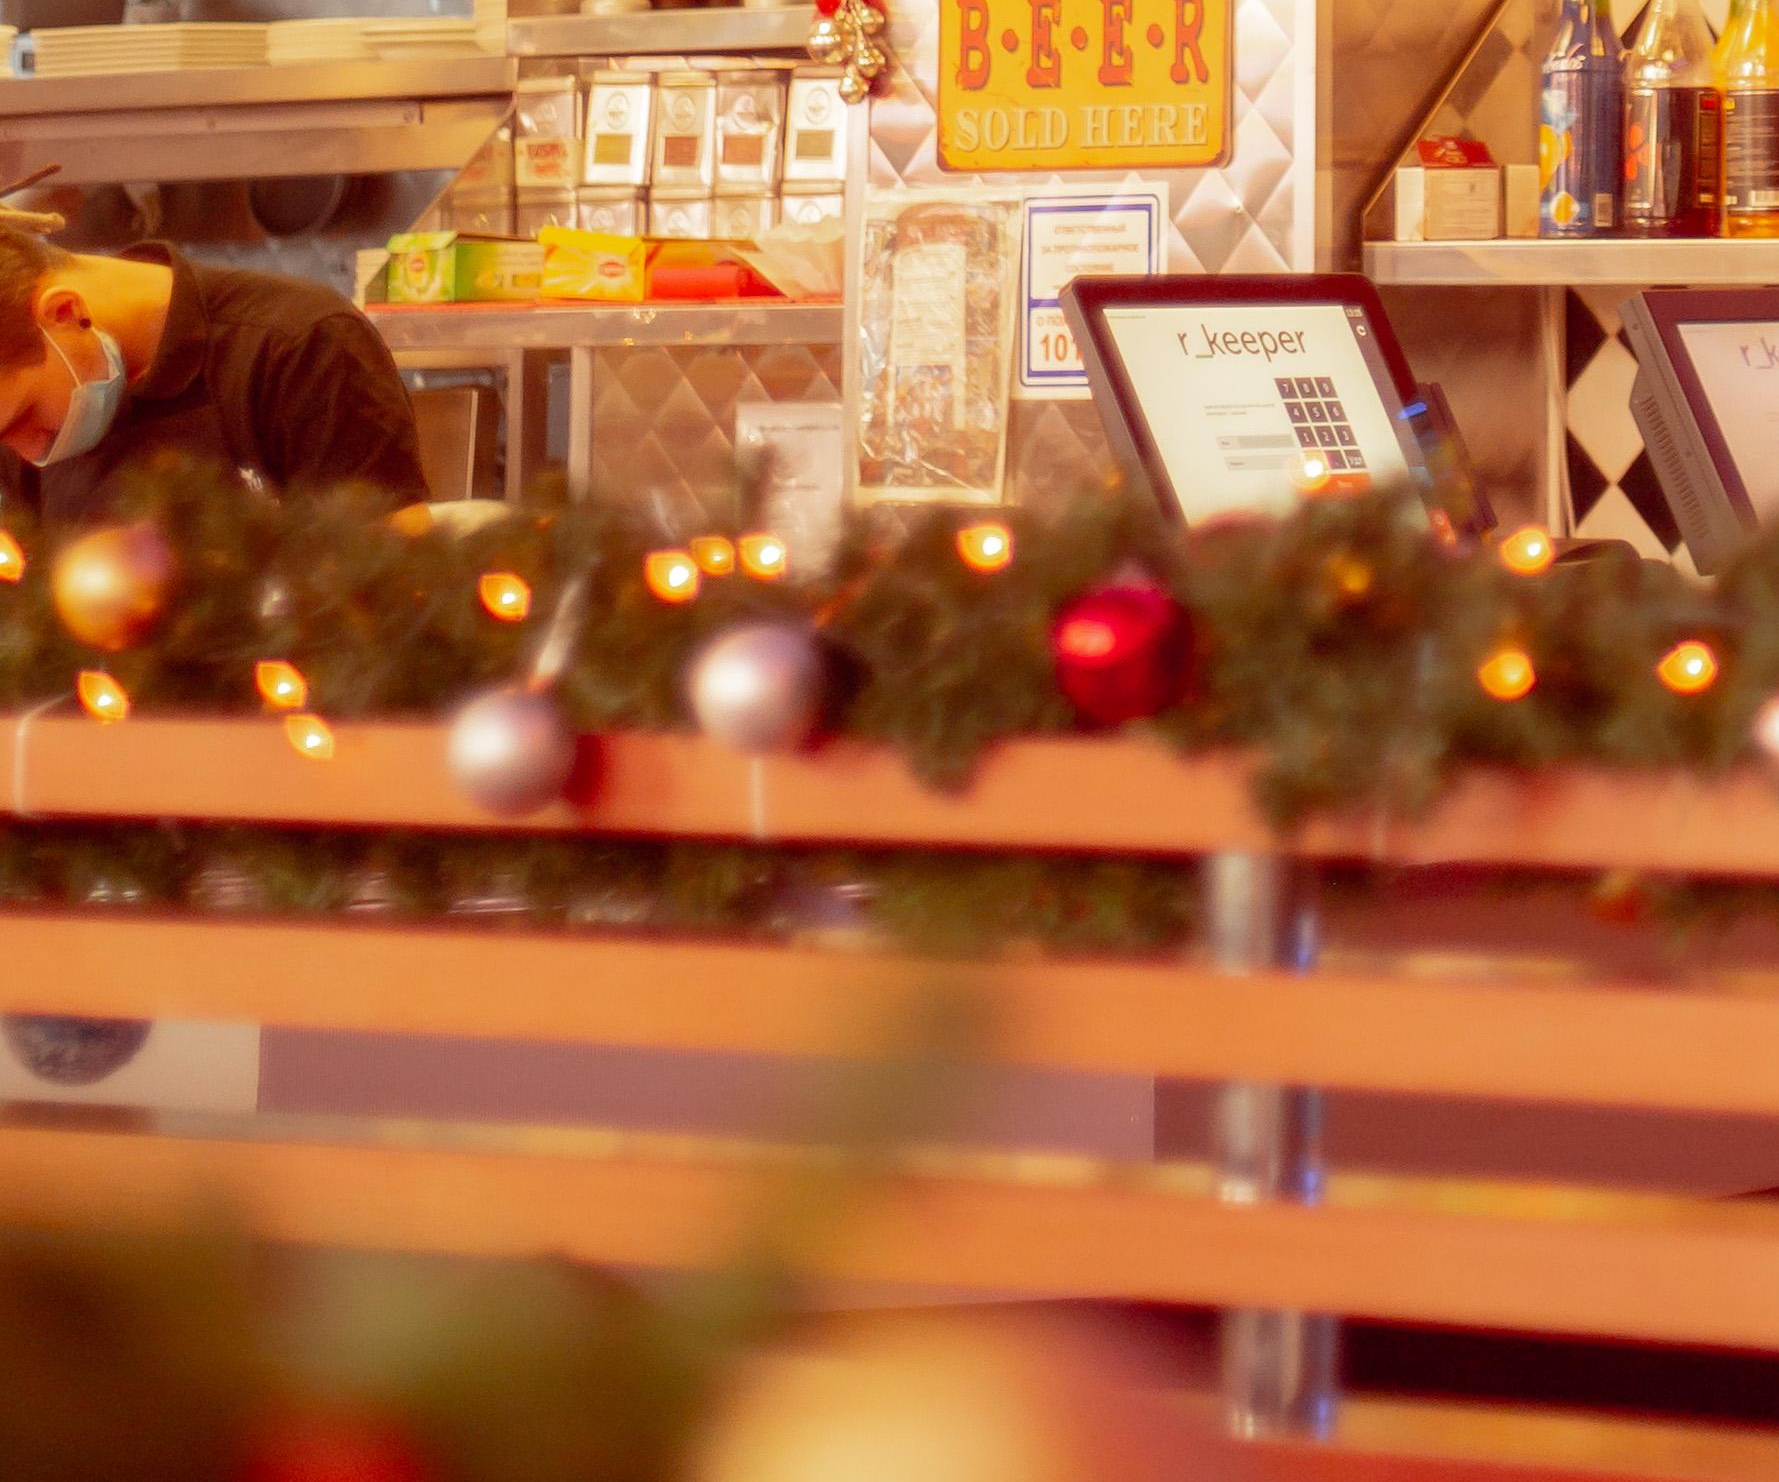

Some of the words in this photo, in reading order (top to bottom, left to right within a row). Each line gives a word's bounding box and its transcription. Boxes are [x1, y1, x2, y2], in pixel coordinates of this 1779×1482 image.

[955, 105, 1069, 153] SOLD
[1080, 102, 1209, 149] HERE
[1176, 323, 1307, 363] r_keeper
